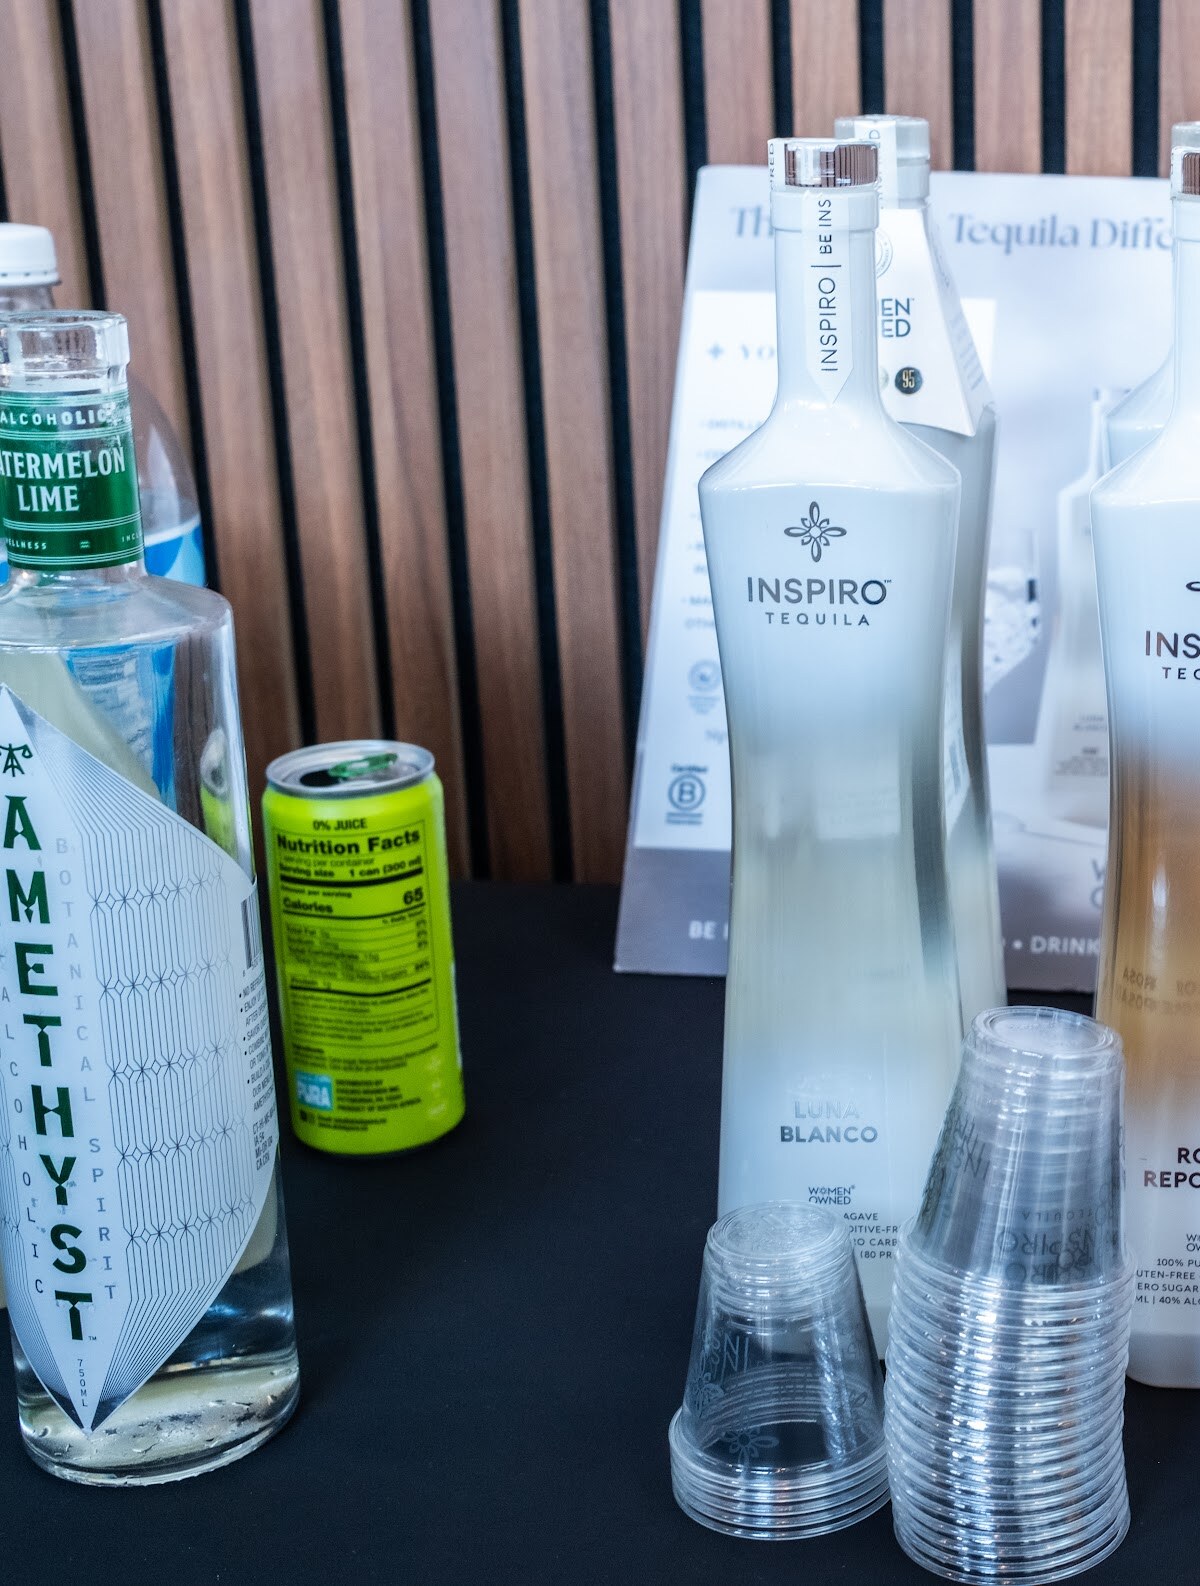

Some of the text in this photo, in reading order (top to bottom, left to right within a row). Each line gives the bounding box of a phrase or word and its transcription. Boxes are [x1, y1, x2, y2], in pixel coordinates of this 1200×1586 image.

[951, 214, 1079, 254] Tequila
[819, 234, 832, 255] BE
[819, 277, 838, 372] INSPIRO
[902, 370, 915, 387] 95
[17, 484, 80, 512] LIME
[765, 612, 870, 626] TEQUILA
[334, 818, 367, 831] JUICE
[277, 830, 420, 855] Nutrition Facts
[283, 886, 424, 913] Calories 65
[688, 920, 716, 940] BE
[3, 795, 92, 1341] AMETHYST
[56, 838, 116, 1300] BOTANICAL SPIRIT
[794, 1101, 860, 1119] LUNA
[780, 1125, 878, 1143] BLANCO
[808, 1196, 852, 1205] OWNED
[843, 1212, 879, 1221] AGAVE
[1156, 1258, 1184, 1267] 100%
[1162, 1284, 1199, 1293] SUGAR
[1159, 1296, 1181, 1305] 40%
[77, 1358, 88, 1407] 750ML
